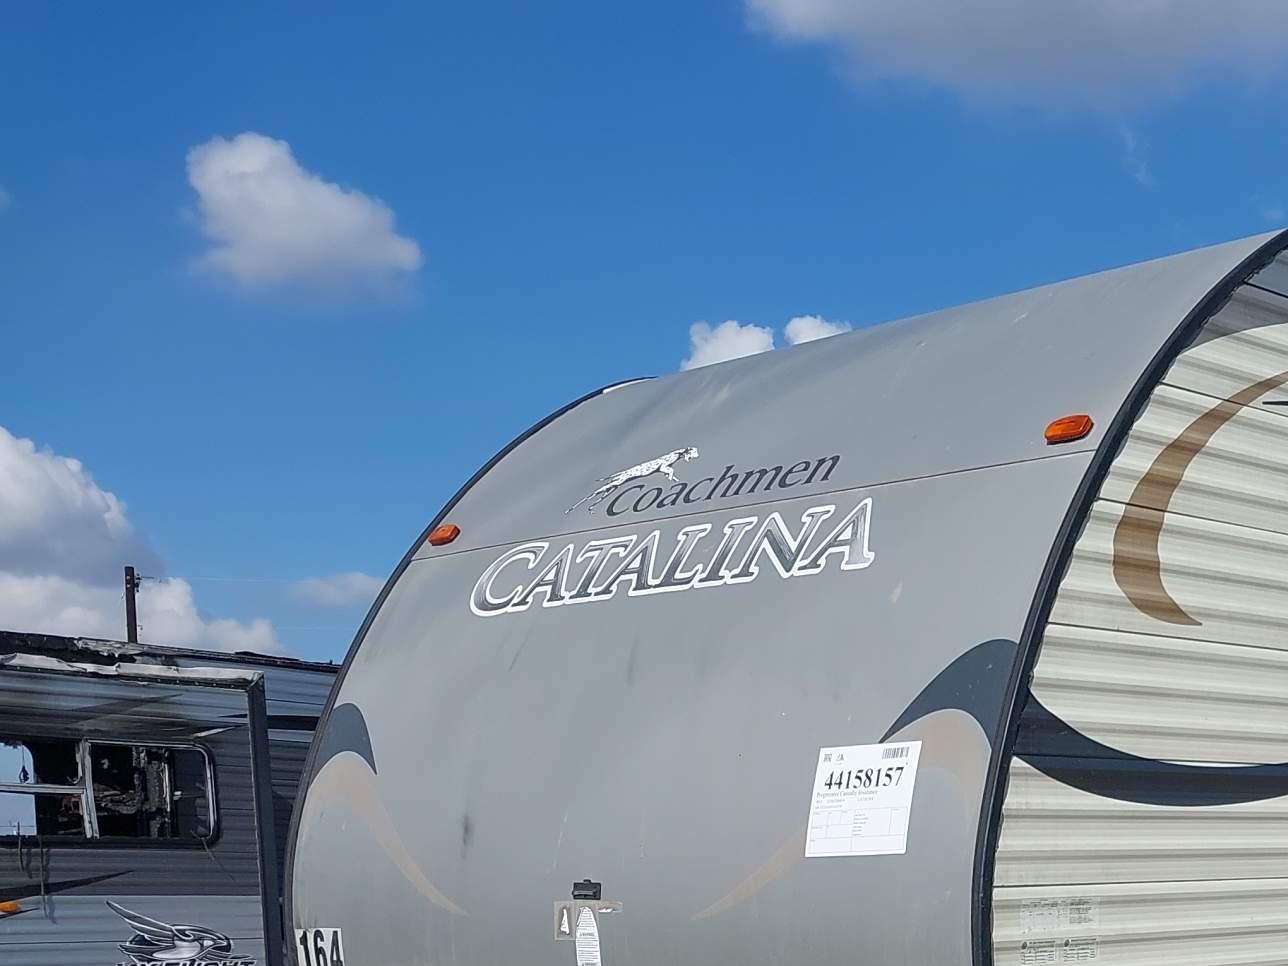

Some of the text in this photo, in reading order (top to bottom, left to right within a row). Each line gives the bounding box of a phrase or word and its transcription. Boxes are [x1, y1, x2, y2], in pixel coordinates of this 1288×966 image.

[606, 454, 840, 517] Coachmen
[469, 497, 875, 617] CATALINA
[825, 767, 904, 790] 44158157
